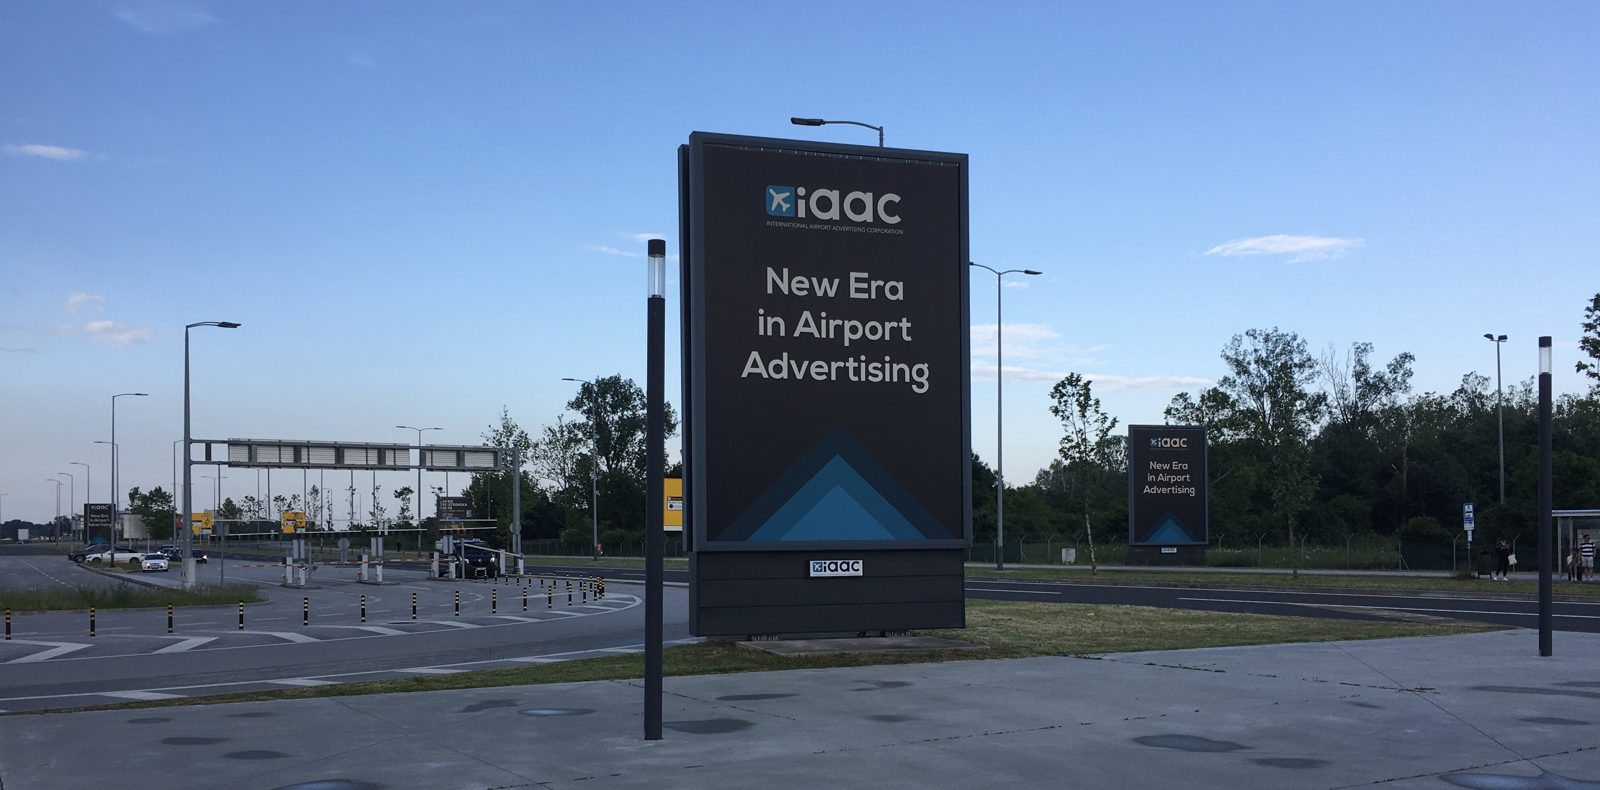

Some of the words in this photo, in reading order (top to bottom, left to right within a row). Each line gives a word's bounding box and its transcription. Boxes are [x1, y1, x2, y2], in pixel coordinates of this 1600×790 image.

[797, 186, 902, 225] iaac
[766, 220, 808, 229] INTERNATIONAL
[809, 223, 831, 231] AIRPORT
[831, 225, 866, 233] ADVERTISING
[866, 227, 904, 235] CORPORATION
[766, 266, 840, 298] New
[849, 271, 904, 301] Era
[758, 308, 786, 337] in
[793, 310, 912, 347] Airport
[740, 350, 930, 394] Advertising
[1149, 461, 1170, 470] New
[1172, 461, 1188, 470] Era
[1147, 473, 1156, 482] in
[1157, 473, 1191, 484] Airport
[1143, 485, 1196, 497] Advertising
[823, 561, 860, 572] iaac
